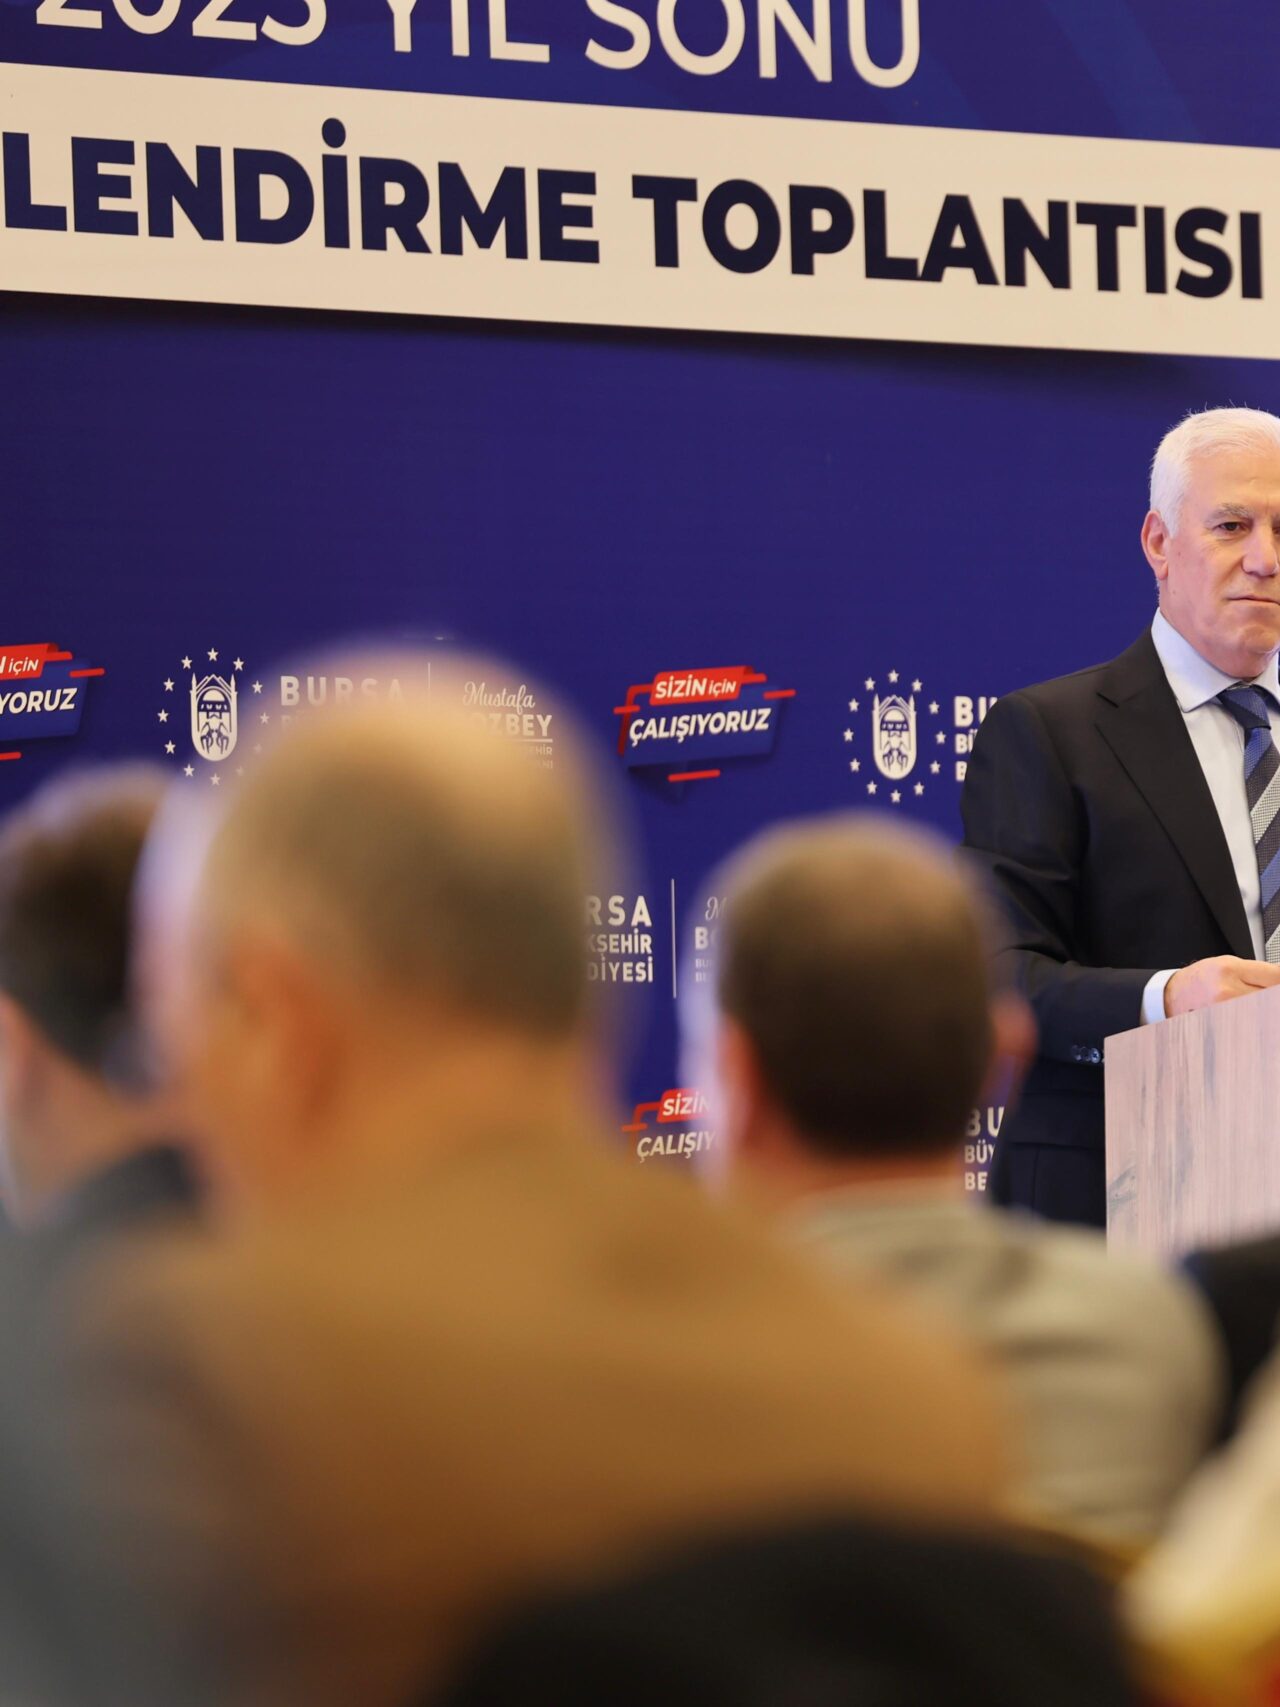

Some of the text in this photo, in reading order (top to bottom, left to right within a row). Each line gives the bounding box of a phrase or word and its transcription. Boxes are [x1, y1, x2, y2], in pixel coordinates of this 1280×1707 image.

[585, 0, 920, 88] SONU
[2, 117, 1262, 300] LENDİRME TOPLANTISI
[463, 681, 536, 715] Mustafa
[655, 674, 707, 698] SİZİN
[629, 708, 771, 747] ÇALIŞIYORUZ
